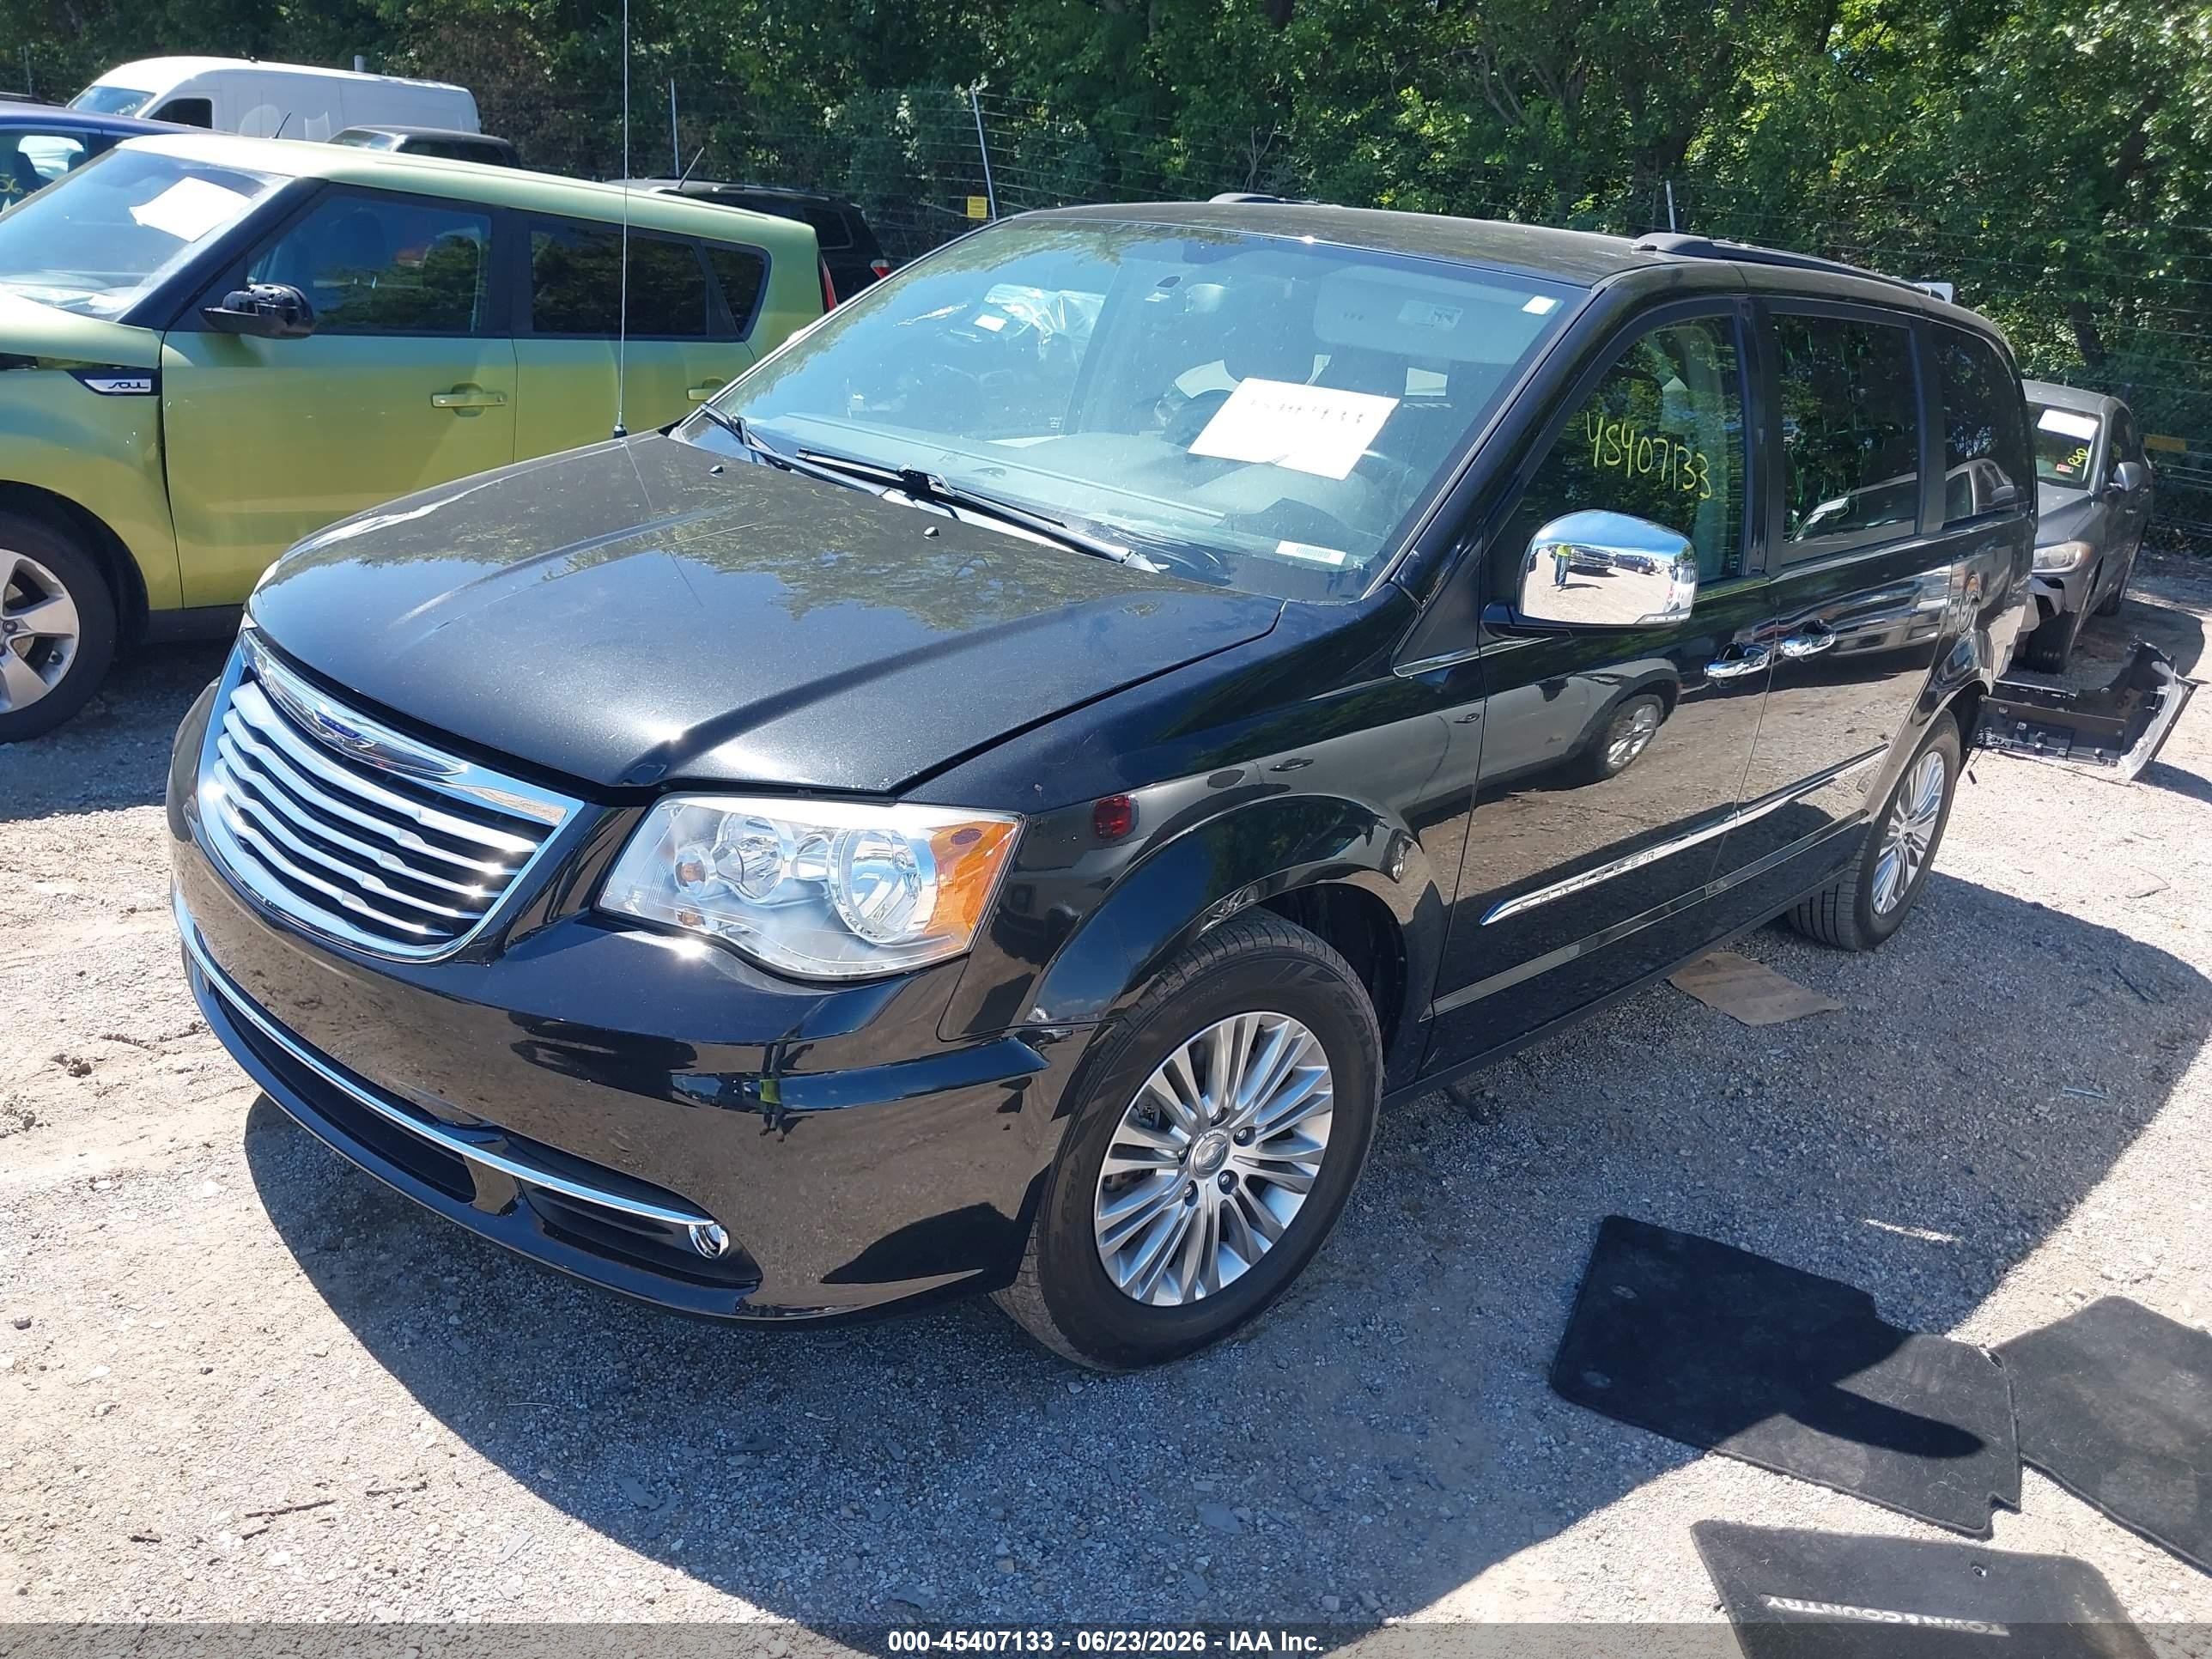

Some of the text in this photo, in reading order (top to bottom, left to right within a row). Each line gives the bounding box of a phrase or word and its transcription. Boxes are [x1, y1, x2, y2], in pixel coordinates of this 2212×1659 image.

[1586, 411, 1712, 499] 45407133
[1520, 851, 1655, 908] CHRYSLER
[1765, 1595, 1903, 1623] COUNTRY
[1921, 1617, 2009, 1636] TOWN
